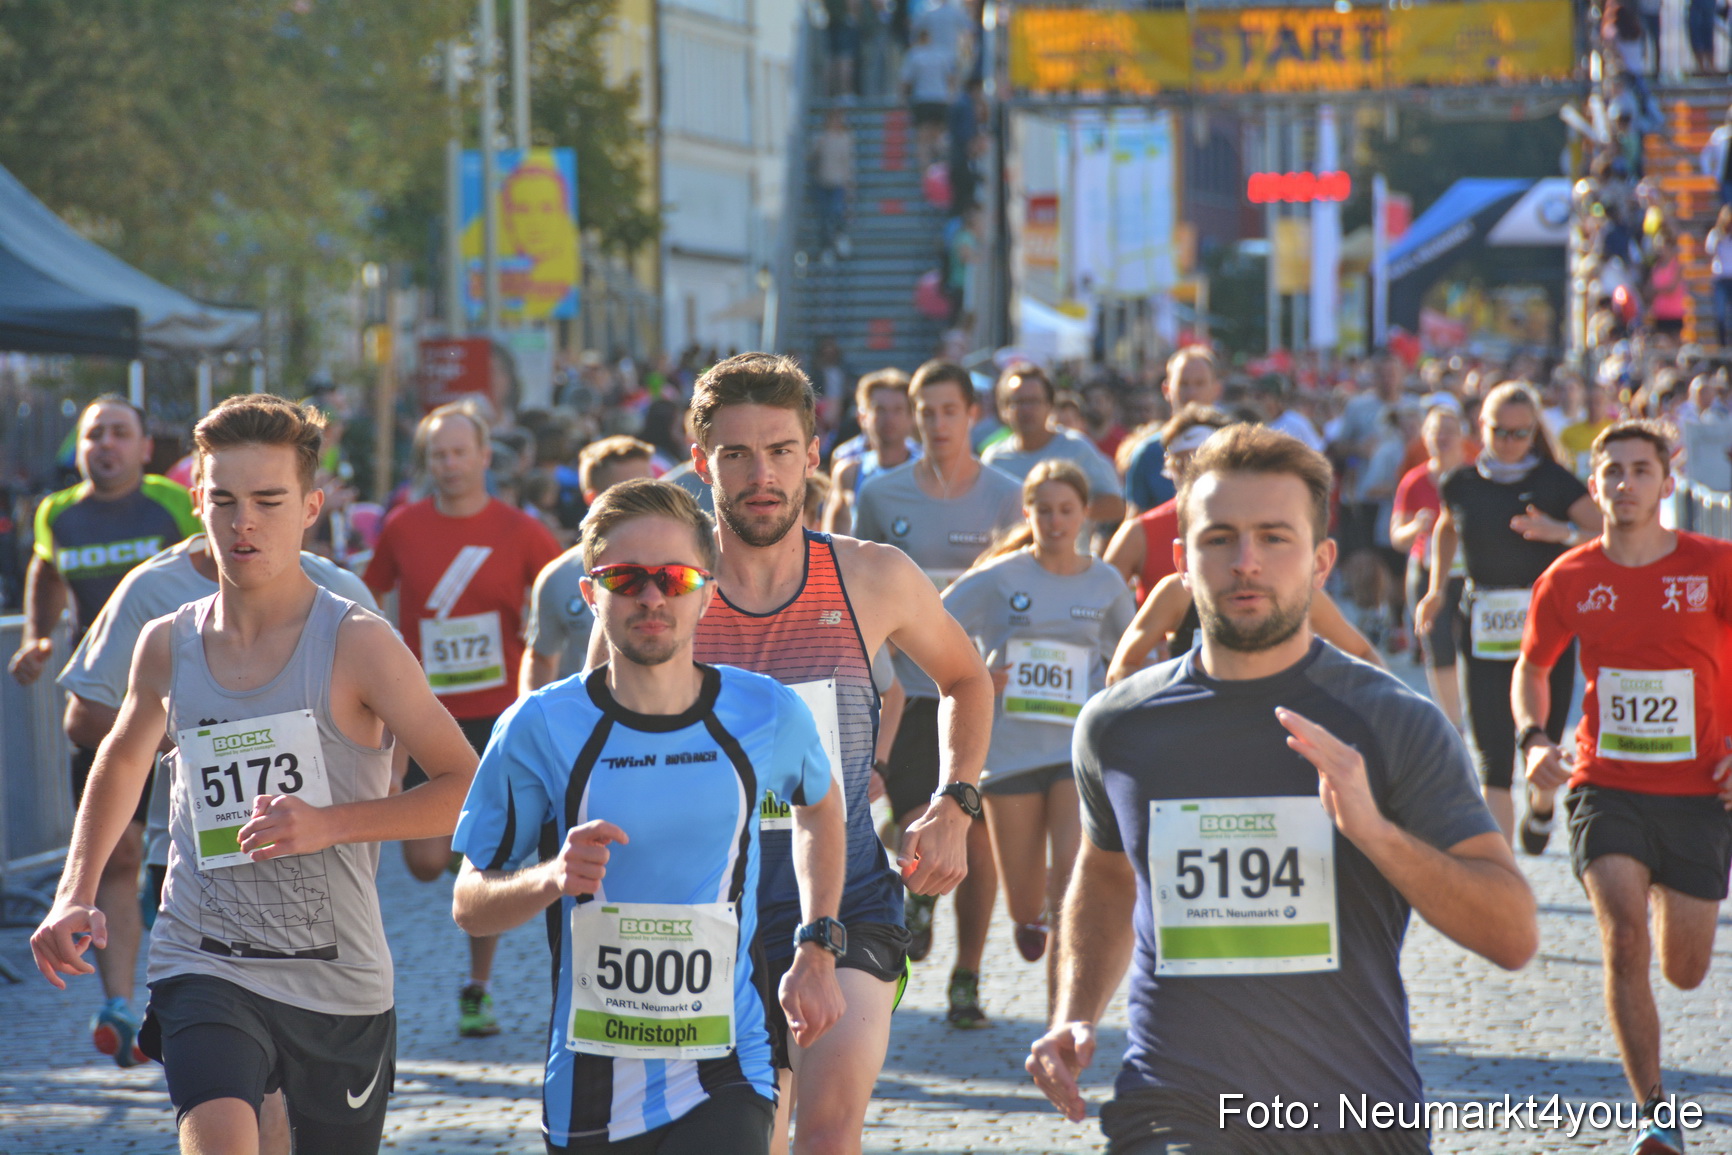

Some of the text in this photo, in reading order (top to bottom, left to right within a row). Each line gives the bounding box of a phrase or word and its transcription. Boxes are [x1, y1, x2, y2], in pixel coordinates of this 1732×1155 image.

[1191, 24, 1386, 71] START
[58, 536, 163, 571] BOCK
[433, 634, 491, 662] 5172
[1018, 662, 1073, 691] 5061
[1611, 696, 1678, 723] 5122
[212, 728, 275, 752] BOCK
[201, 753, 303, 807] 5173
[216, 810, 243, 822] PARTL
[1200, 814, 1277, 832] BOCK
[1176, 846, 1304, 899] 5194
[619, 918, 693, 935] BOCK
[1187, 908, 1279, 918] PARTL Neumarkt
[596, 945, 712, 995] 5000
[605, 997, 688, 1012] PARTL Neumarkt
[605, 1018, 697, 1046] Christoph
